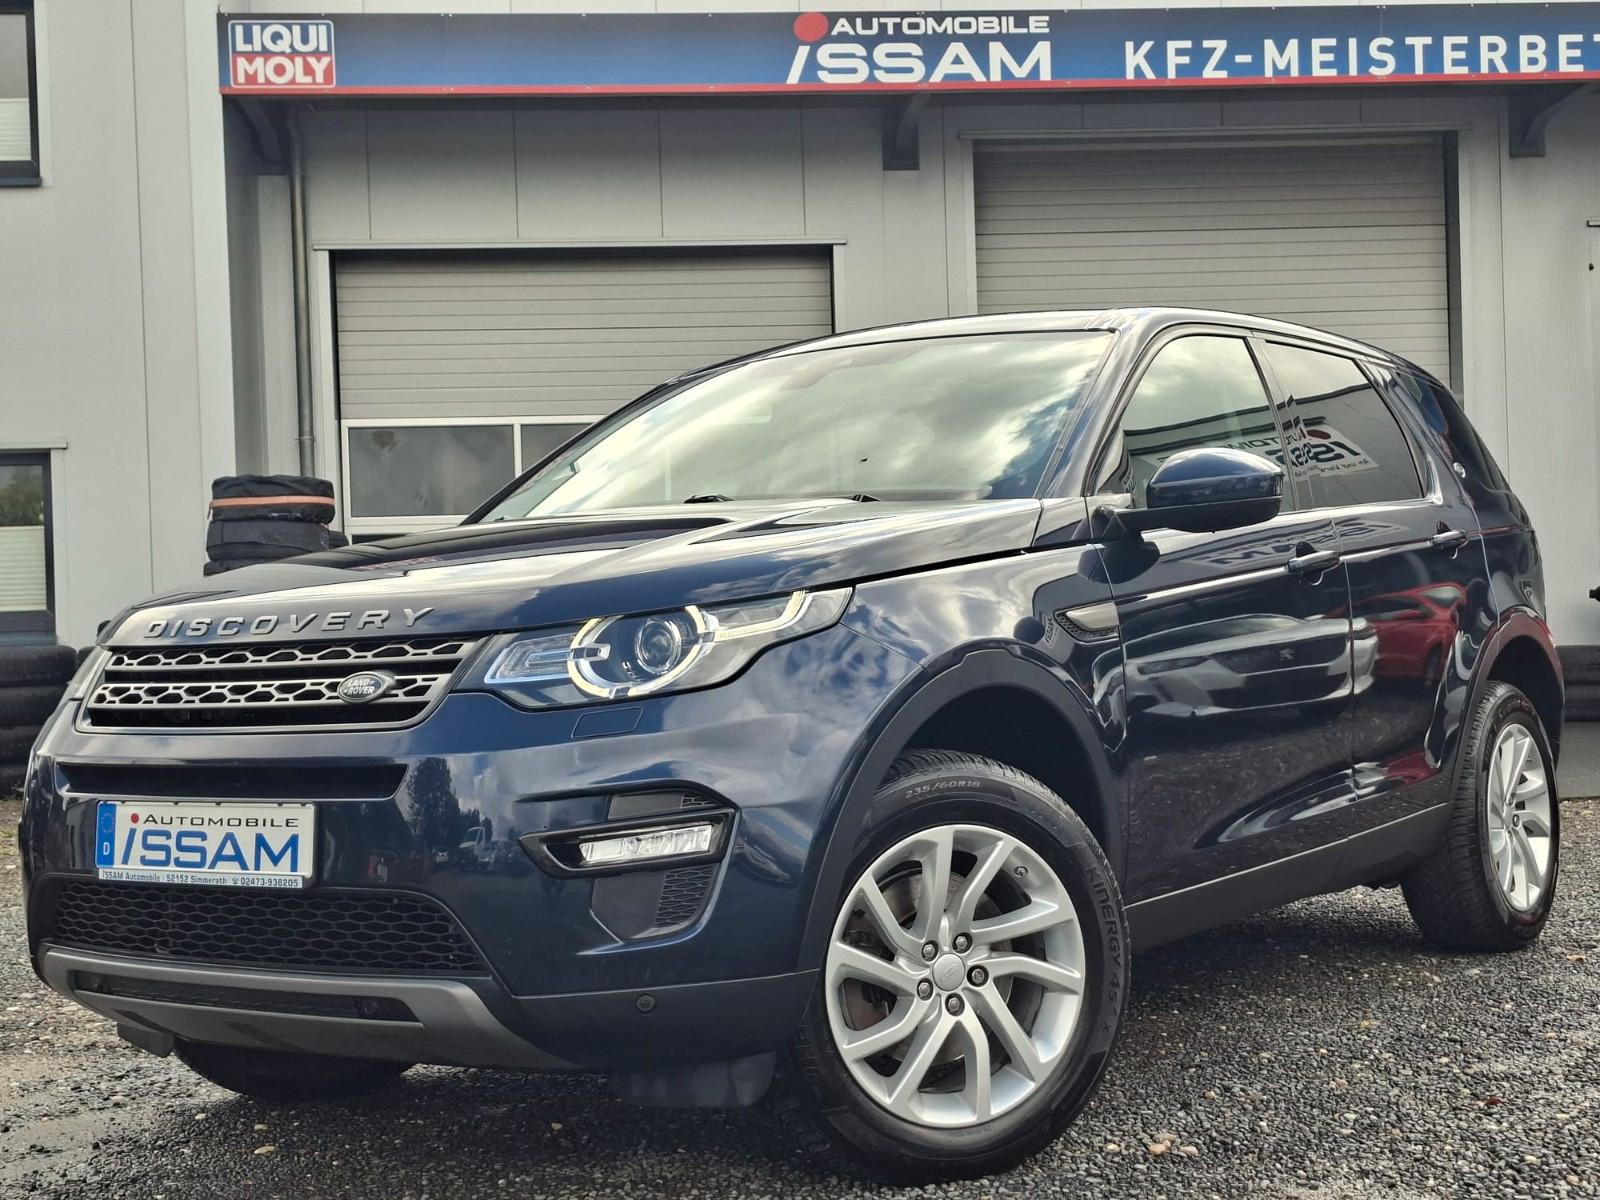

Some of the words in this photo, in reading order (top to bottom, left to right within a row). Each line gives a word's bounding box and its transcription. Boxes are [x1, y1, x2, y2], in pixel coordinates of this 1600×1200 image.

[831, 15, 1050, 36] AUTOMOBILE
[235, 24, 328, 53] LIQUI
[1125, 33, 1600, 79] KFZ-MEISTERBE
[236, 56, 331, 84] MOLY
[144, 607, 434, 639] DISCOVERY
[347, 678, 371, 688] LAND
[347, 686, 375, 695] ROVER
[143, 813, 299, 828] AUTOMOBILE
[103, 842, 110, 856] D
[126, 871, 160, 882] Automobile
[190, 875, 227, 885] Simmerath
[240, 877, 299, 887] 02473-938205
[1086, 863, 1121, 968] KINERGY
